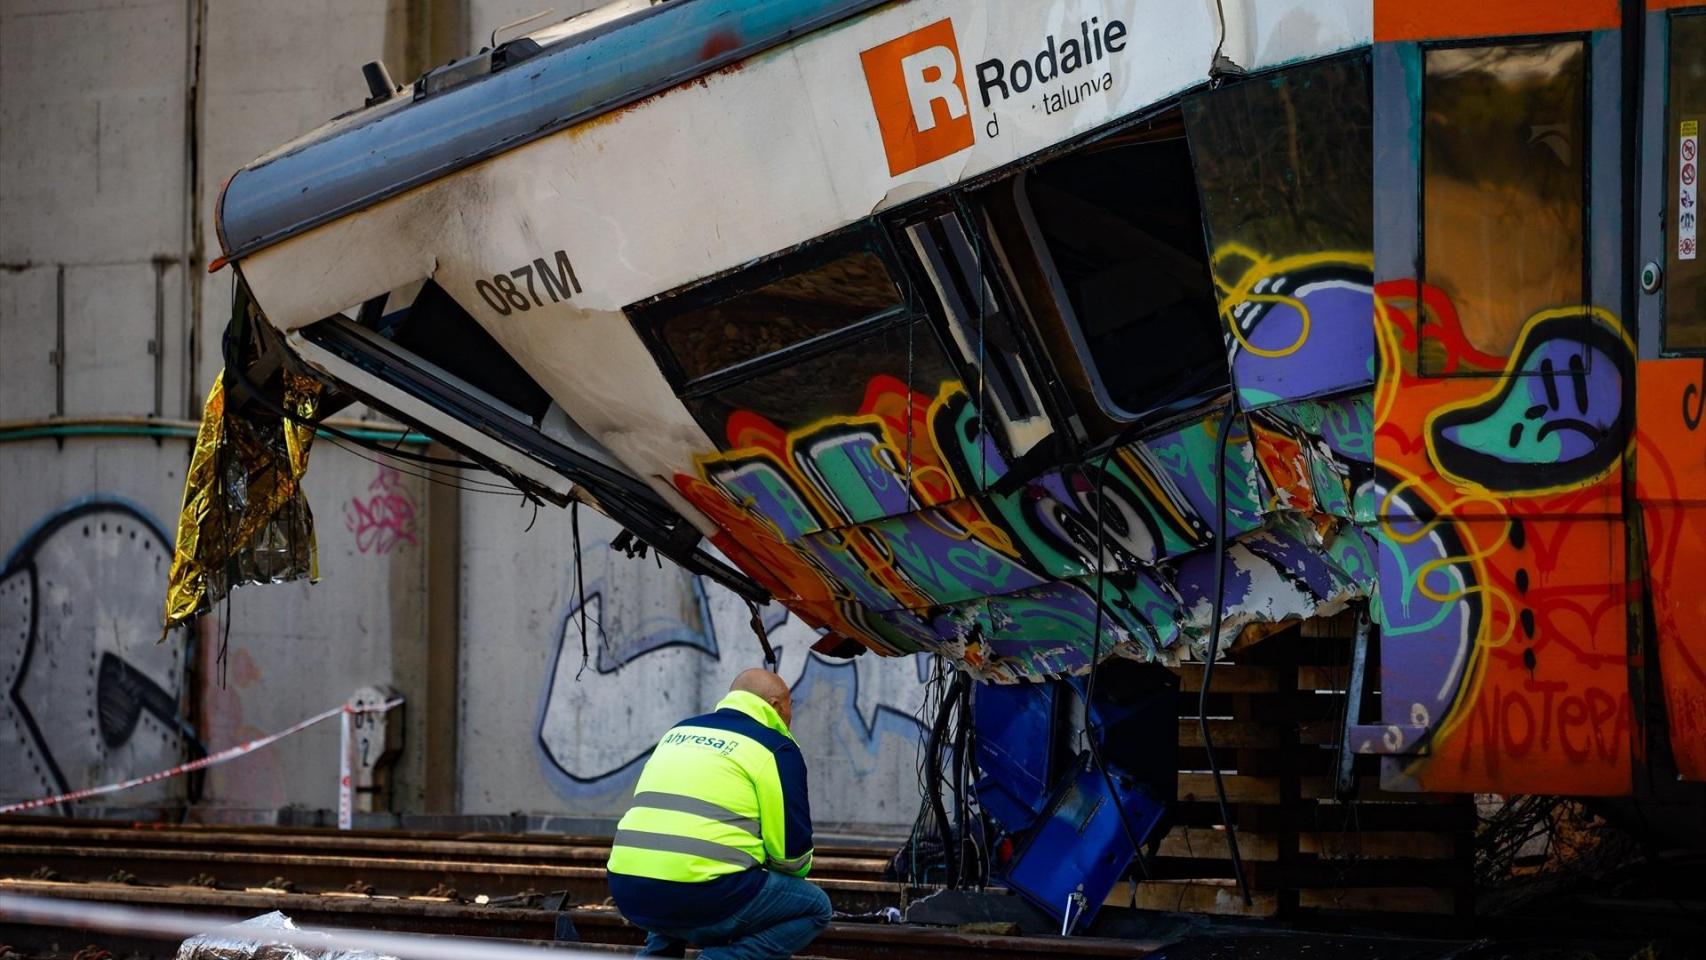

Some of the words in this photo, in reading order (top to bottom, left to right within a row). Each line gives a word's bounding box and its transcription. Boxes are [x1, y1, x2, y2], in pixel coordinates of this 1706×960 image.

[901, 45, 968, 133] R
[975, 16, 1127, 107] Rodalie
[475, 250, 583, 316] 087M
